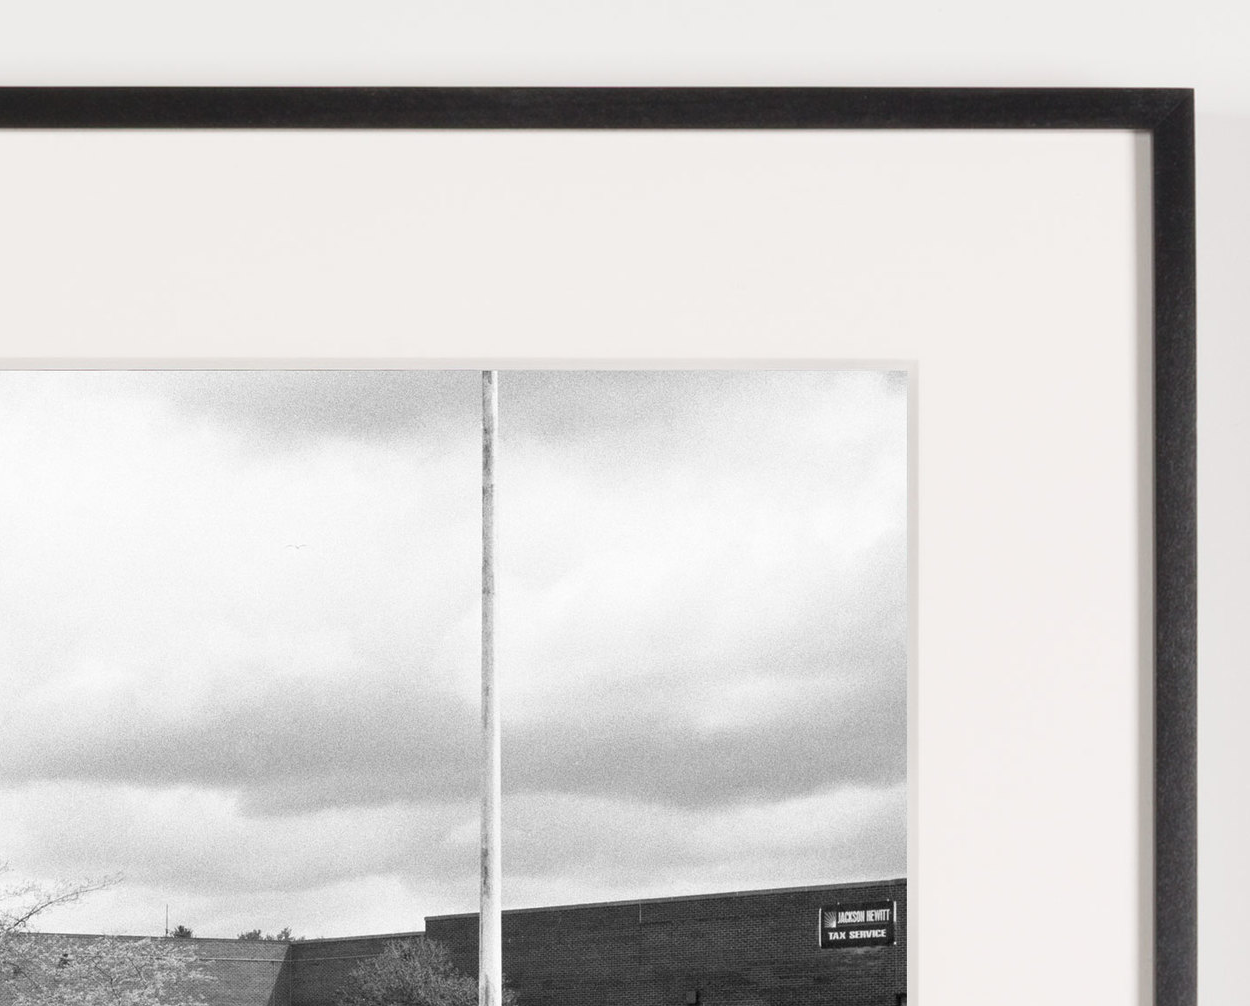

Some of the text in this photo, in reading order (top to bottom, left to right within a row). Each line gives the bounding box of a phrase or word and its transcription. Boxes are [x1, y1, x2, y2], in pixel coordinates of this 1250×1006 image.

[837, 908, 890, 924] JACKSON HEWITT
[828, 929, 887, 941] TAX SERVICE
